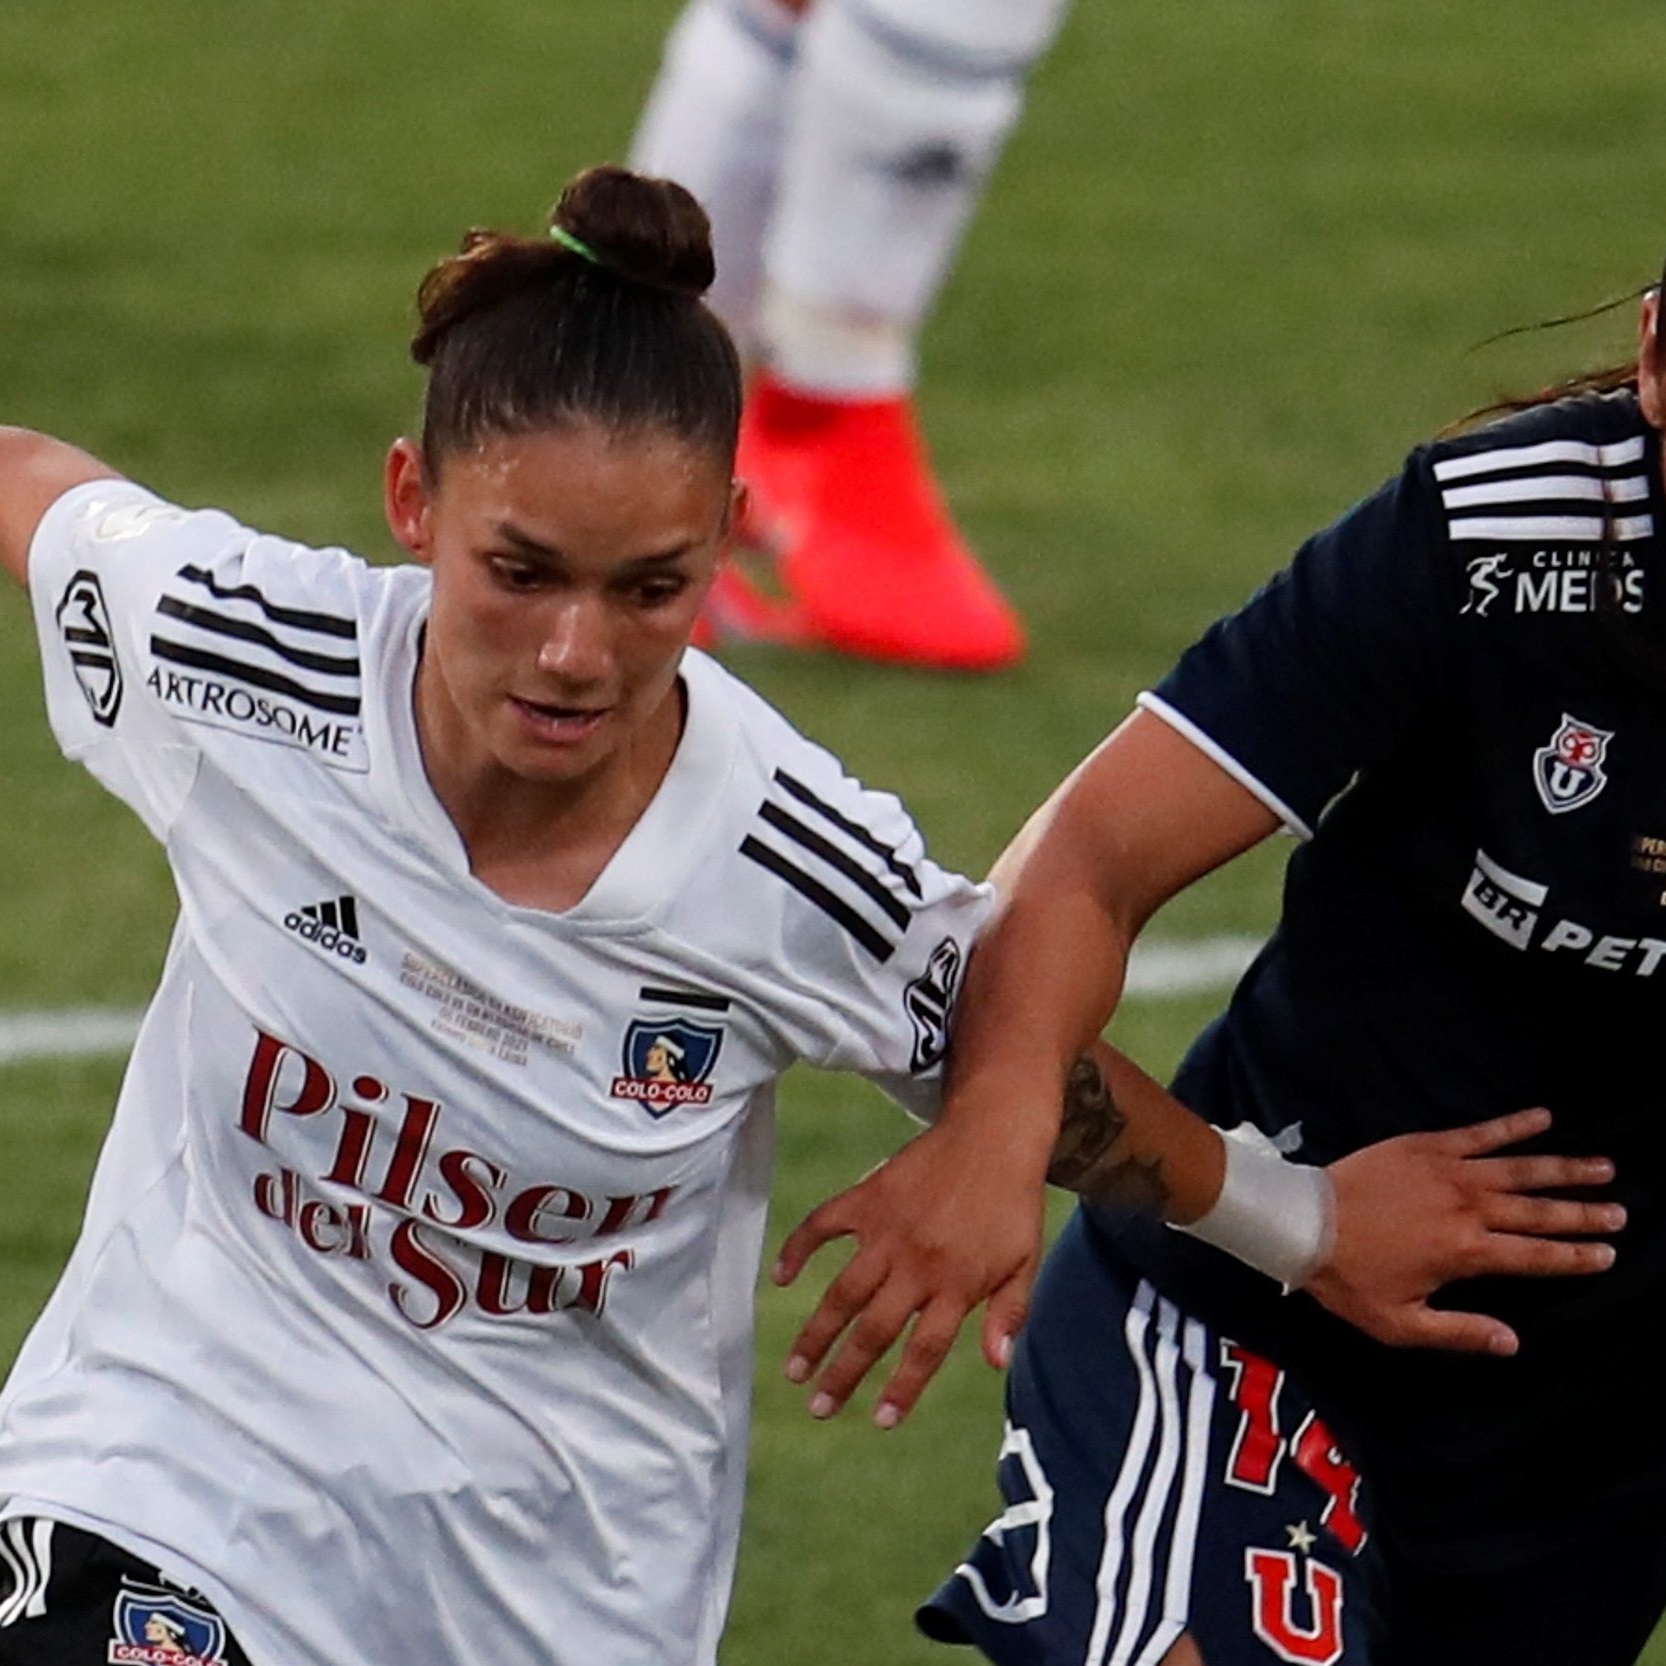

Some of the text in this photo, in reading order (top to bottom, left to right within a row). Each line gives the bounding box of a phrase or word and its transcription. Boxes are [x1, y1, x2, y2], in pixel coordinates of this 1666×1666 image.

[1472, 883, 1528, 931] BR
[284, 909, 367, 965] adidas
[614, 1079, 709, 1103] COLO-COLO
[235, 1024, 680, 1244] Pilsen
[253, 1168, 634, 1329] del Sur
